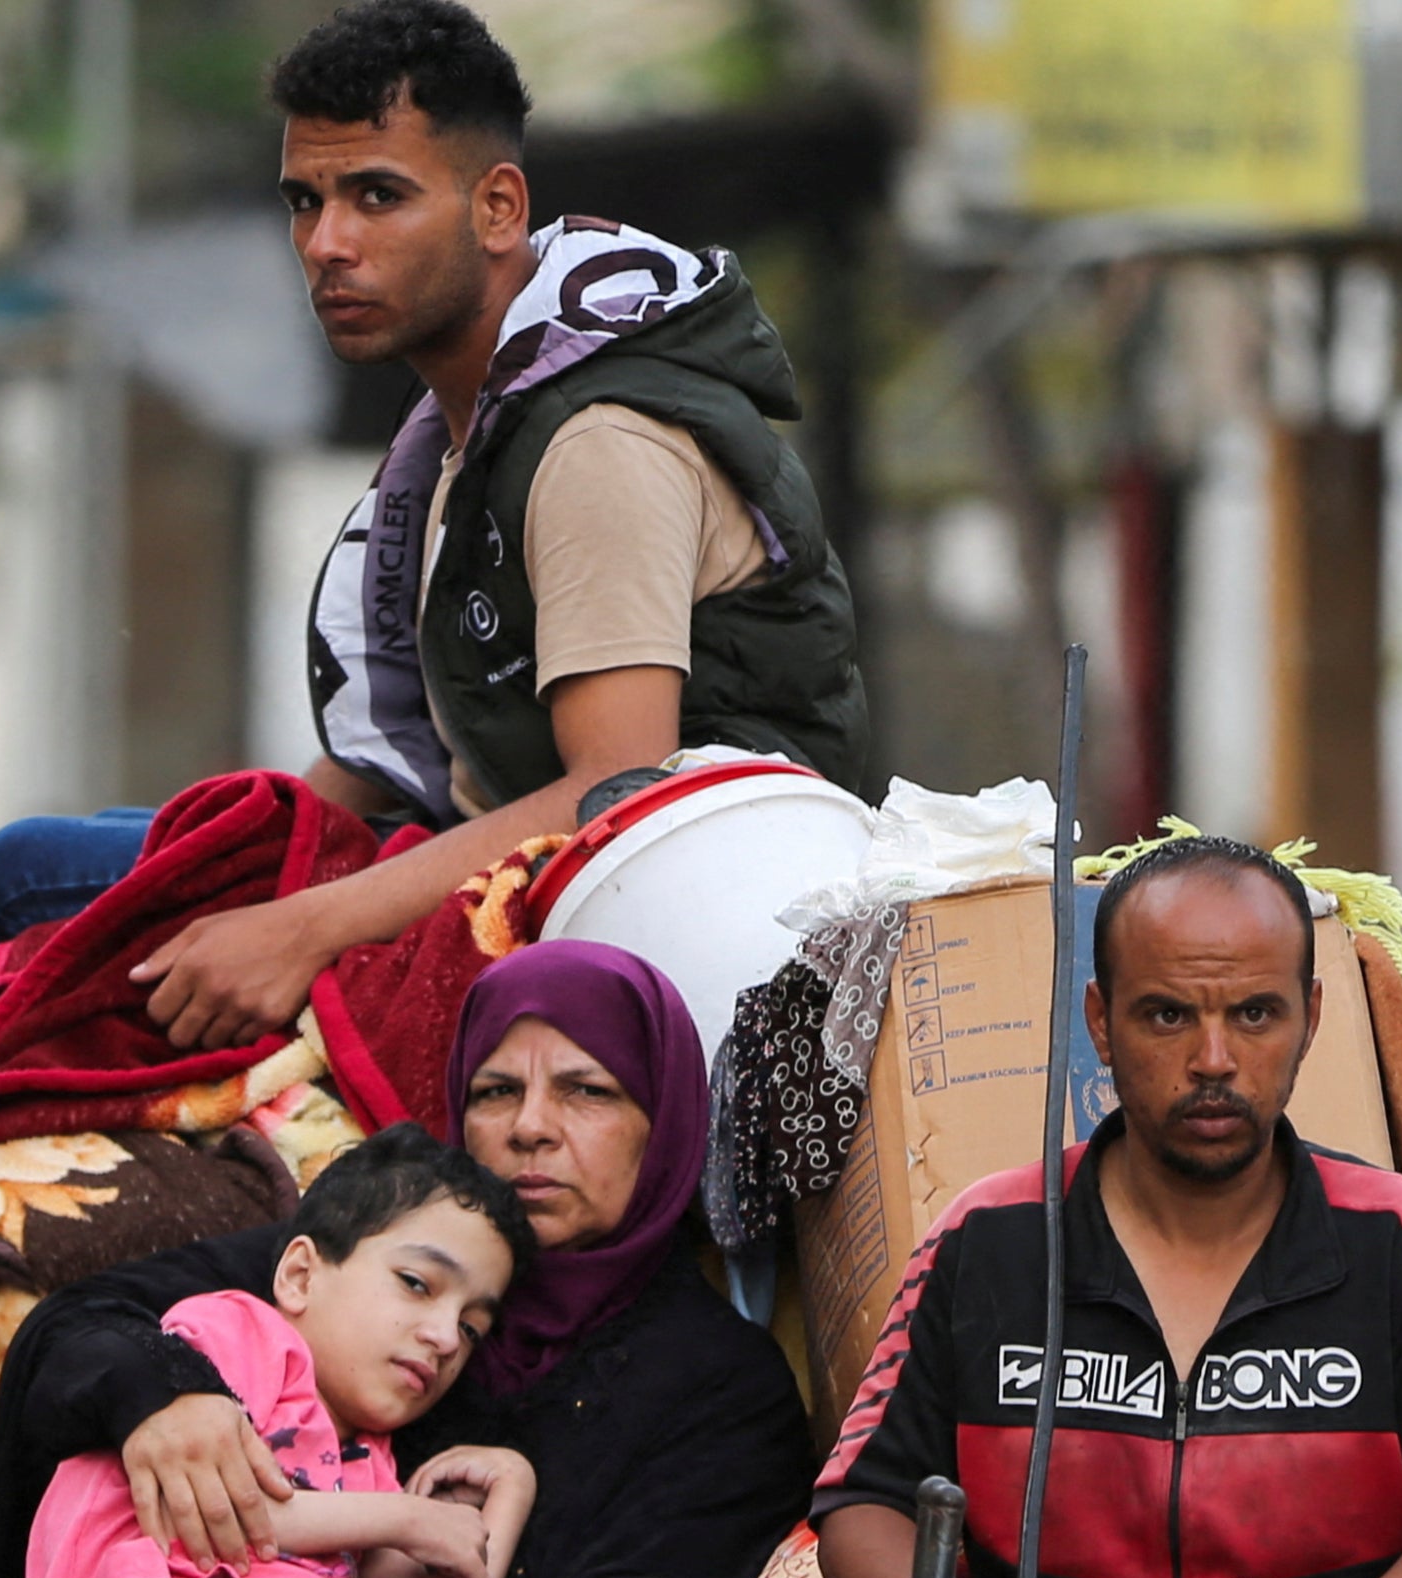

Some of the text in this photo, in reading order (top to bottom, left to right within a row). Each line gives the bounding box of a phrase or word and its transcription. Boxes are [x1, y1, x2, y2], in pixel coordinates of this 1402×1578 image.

[375, 489, 415, 652] NOMCLER
[937, 937, 969, 950] UPWARD
[941, 982, 976, 995] KEEP DRY
[945, 1020, 1032, 1039] KEEP AWAY FROM HEAT
[950, 1072, 987, 1085] MAXIMUM
[988, 1067, 1028, 1079] STACKING
